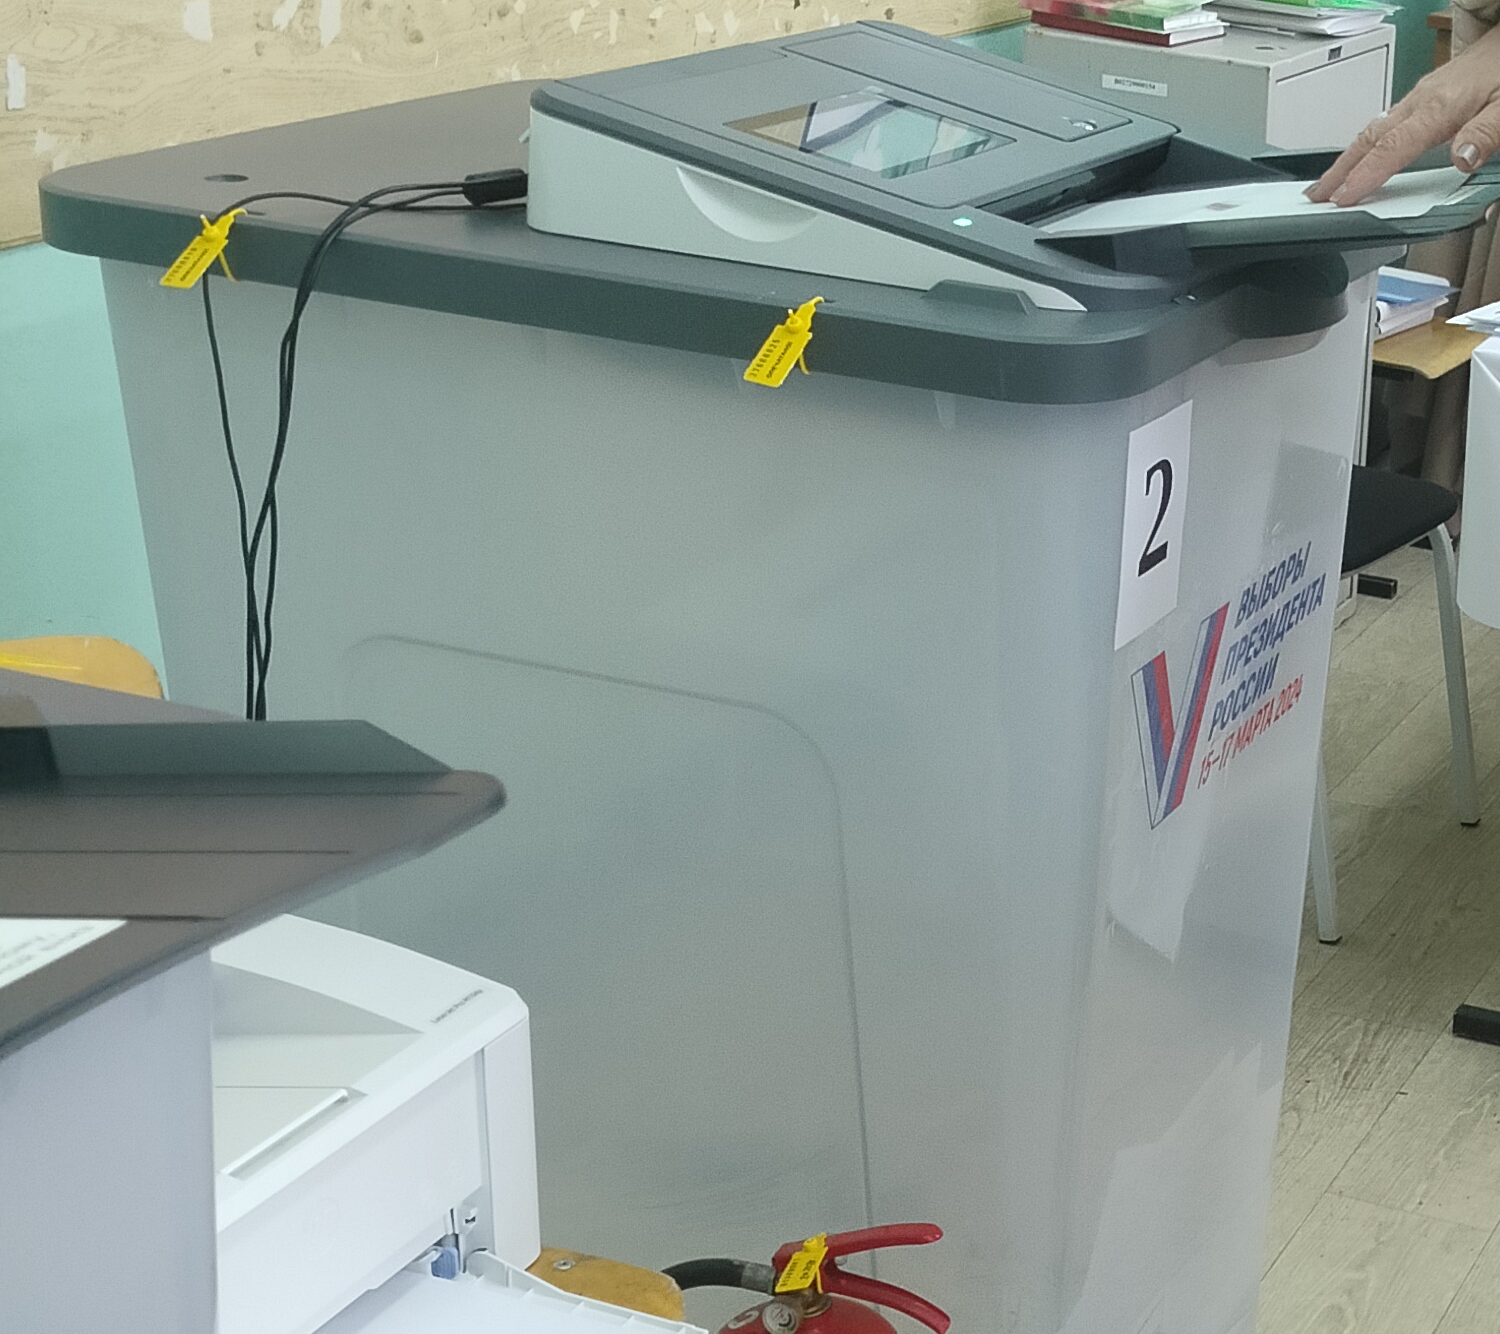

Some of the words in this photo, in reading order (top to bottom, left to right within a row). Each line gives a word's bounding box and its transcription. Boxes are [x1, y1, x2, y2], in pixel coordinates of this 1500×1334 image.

[1137, 458, 1174, 578] 2
[1221, 573, 1326, 685] ПРЕЗИДЕНТА
[1234, 540, 1312, 629] ВЫБОРЫ
[1208, 652, 1280, 742] РОССИИ
[1232, 697, 1275, 759] МАРТА
[1273, 673, 1304, 723] 2024
